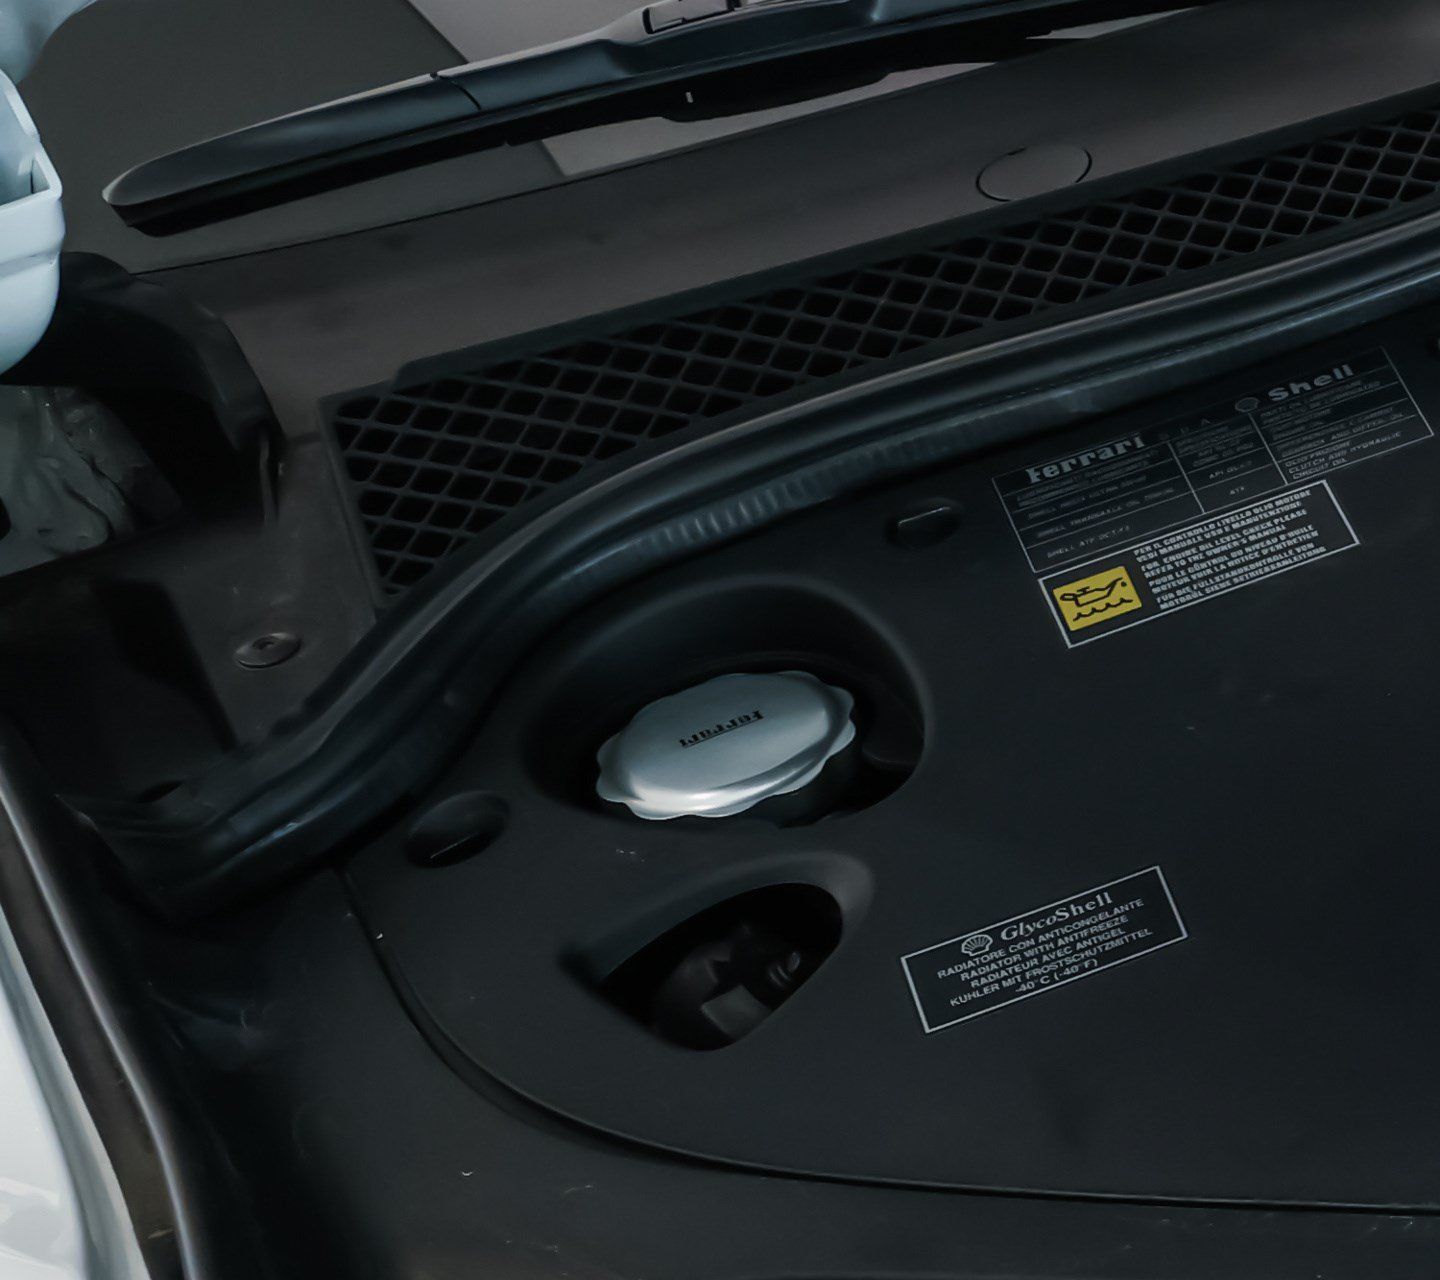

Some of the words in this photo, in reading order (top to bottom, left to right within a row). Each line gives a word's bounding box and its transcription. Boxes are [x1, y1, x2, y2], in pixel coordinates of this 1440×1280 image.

[1268, 364, 1353, 401] Shell
[1026, 436, 1144, 483] Ferrari
[680, 710, 765, 748] Ferrari
[937, 949, 1006, 979] RADIATORE
[1008, 938, 1036, 953] CON
[1038, 899, 1143, 943] ANTICONGELANTE
[1001, 892, 1112, 940] GlycoShell
[960, 954, 1022, 981] RADIATOR
[1023, 942, 1055, 957] WITH
[1057, 915, 1128, 947] ANTIFREEZE
[971, 958, 1039, 988] RADIATEUR
[1042, 946, 1072, 963] AVEC
[1076, 928, 1126, 950] ANTIGEL
[1001, 974, 1022, 987] MIT
[1025, 929, 1152, 979] FROSTSCHUTZMITTEL
